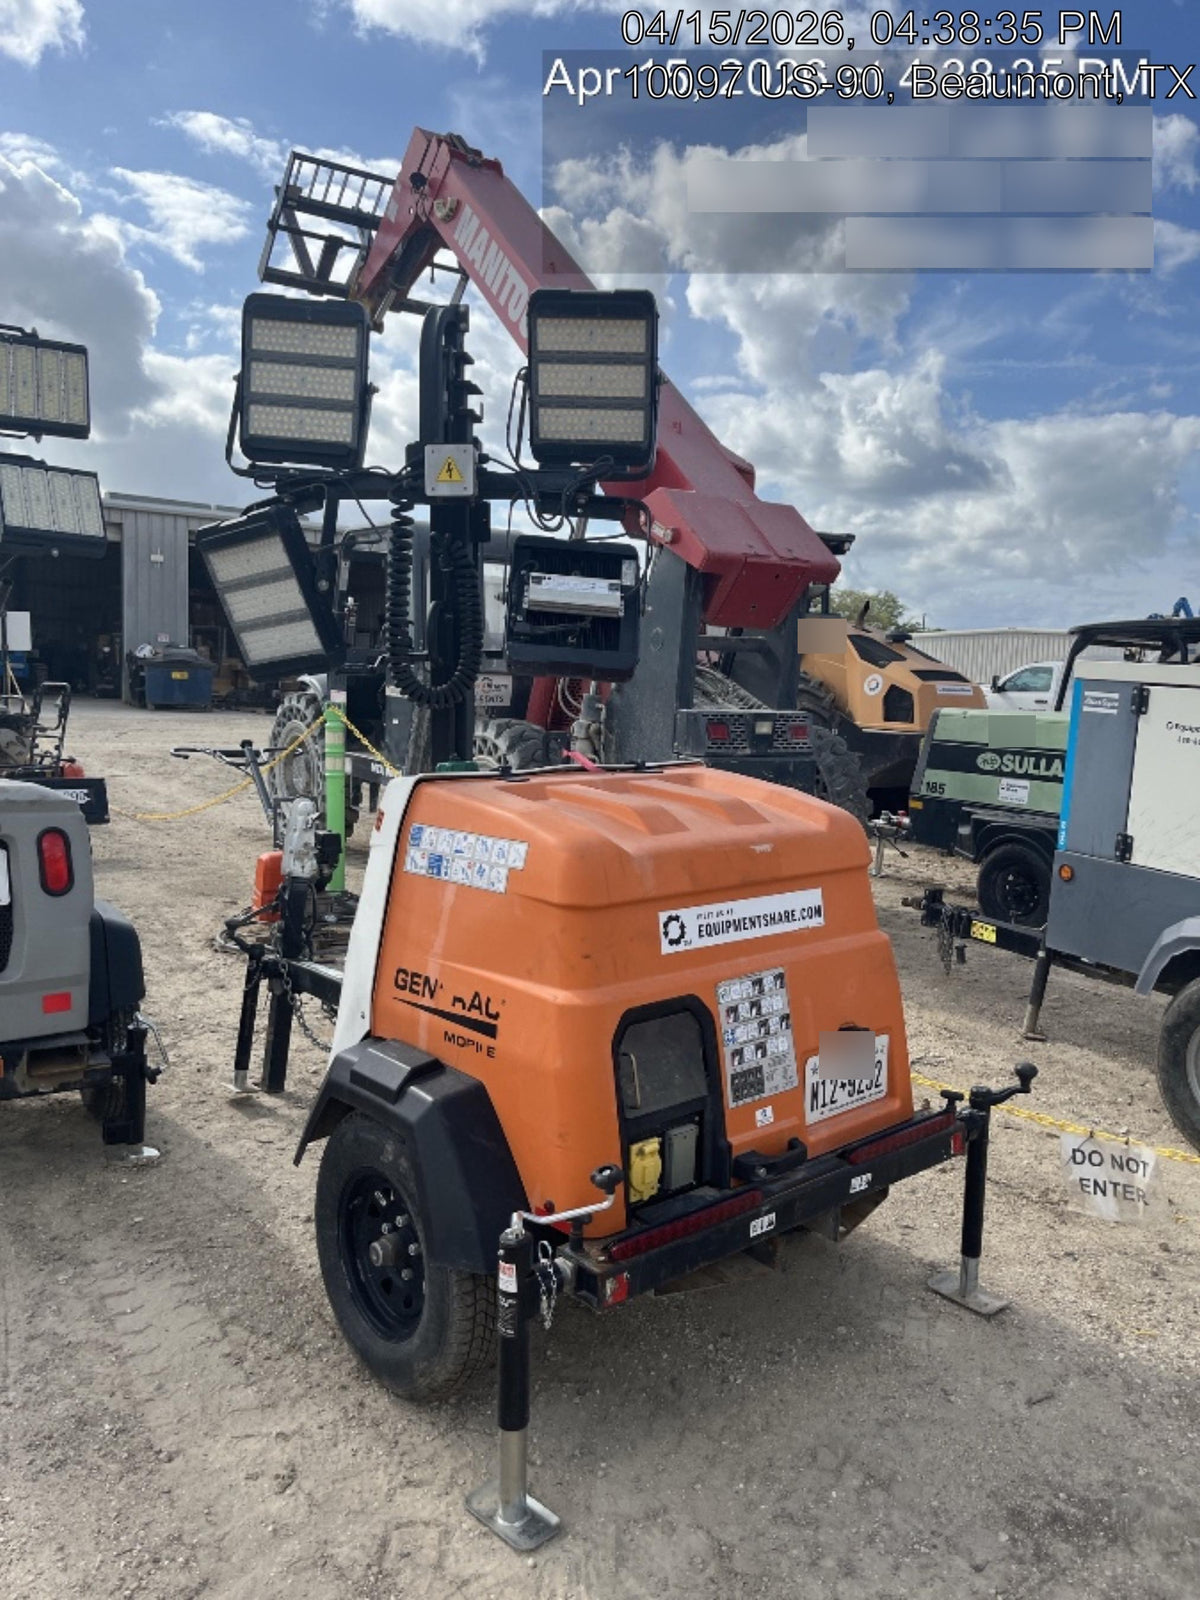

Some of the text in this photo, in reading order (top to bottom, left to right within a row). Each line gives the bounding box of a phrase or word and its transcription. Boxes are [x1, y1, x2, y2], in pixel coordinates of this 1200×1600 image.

[926, 781, 946, 795] 185
[697, 904, 822, 938] EQUIPMENTSHARE.COM
[1071, 1147, 1149, 1178] DO NOT
[1079, 1177, 1150, 1206] ENTER
